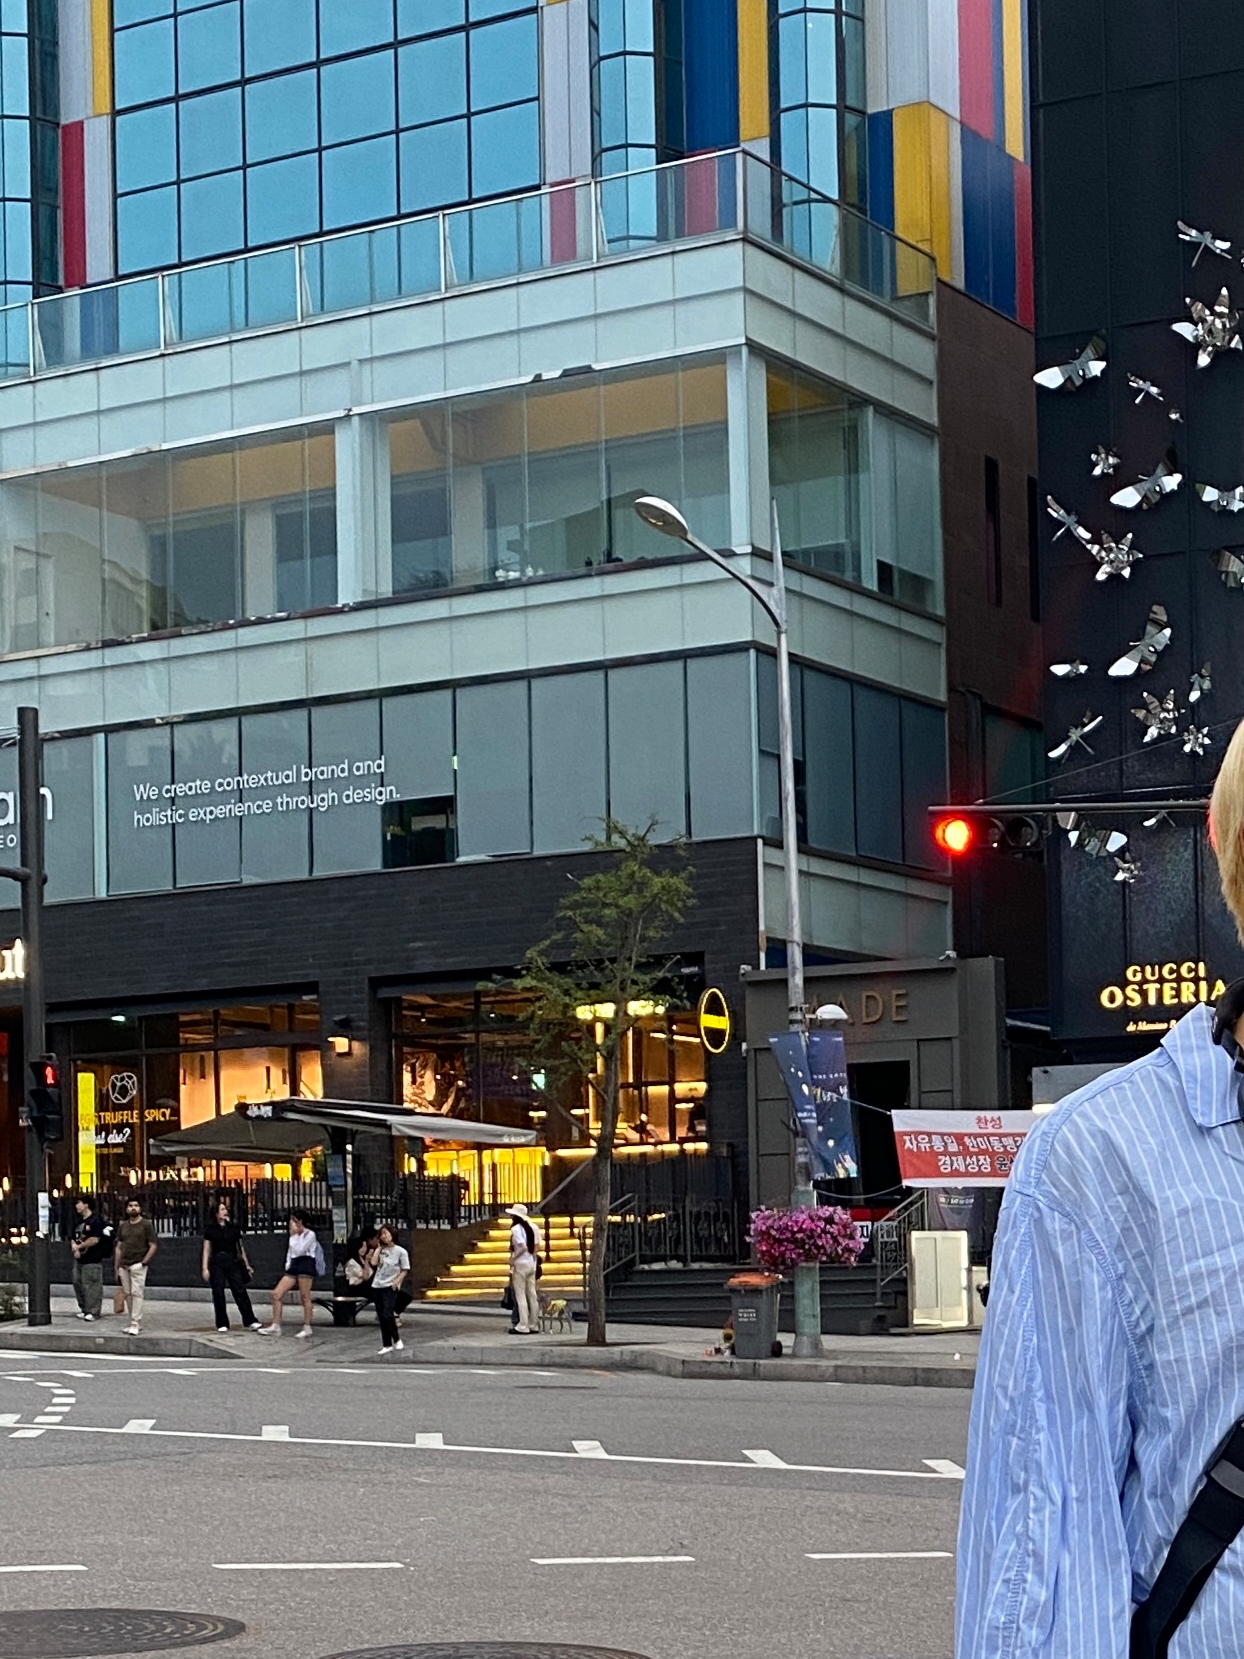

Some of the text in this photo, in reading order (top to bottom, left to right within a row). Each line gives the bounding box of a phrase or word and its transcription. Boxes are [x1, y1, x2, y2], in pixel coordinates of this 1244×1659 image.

[134, 755, 386, 802] We create contextual brand and
[134, 782, 401, 829] holistic experience through design.
[1125, 960, 1206, 982] GUCCI
[1099, 979, 1226, 1009] OSTERIA
[938, 1155, 992, 1173] 경제성장
